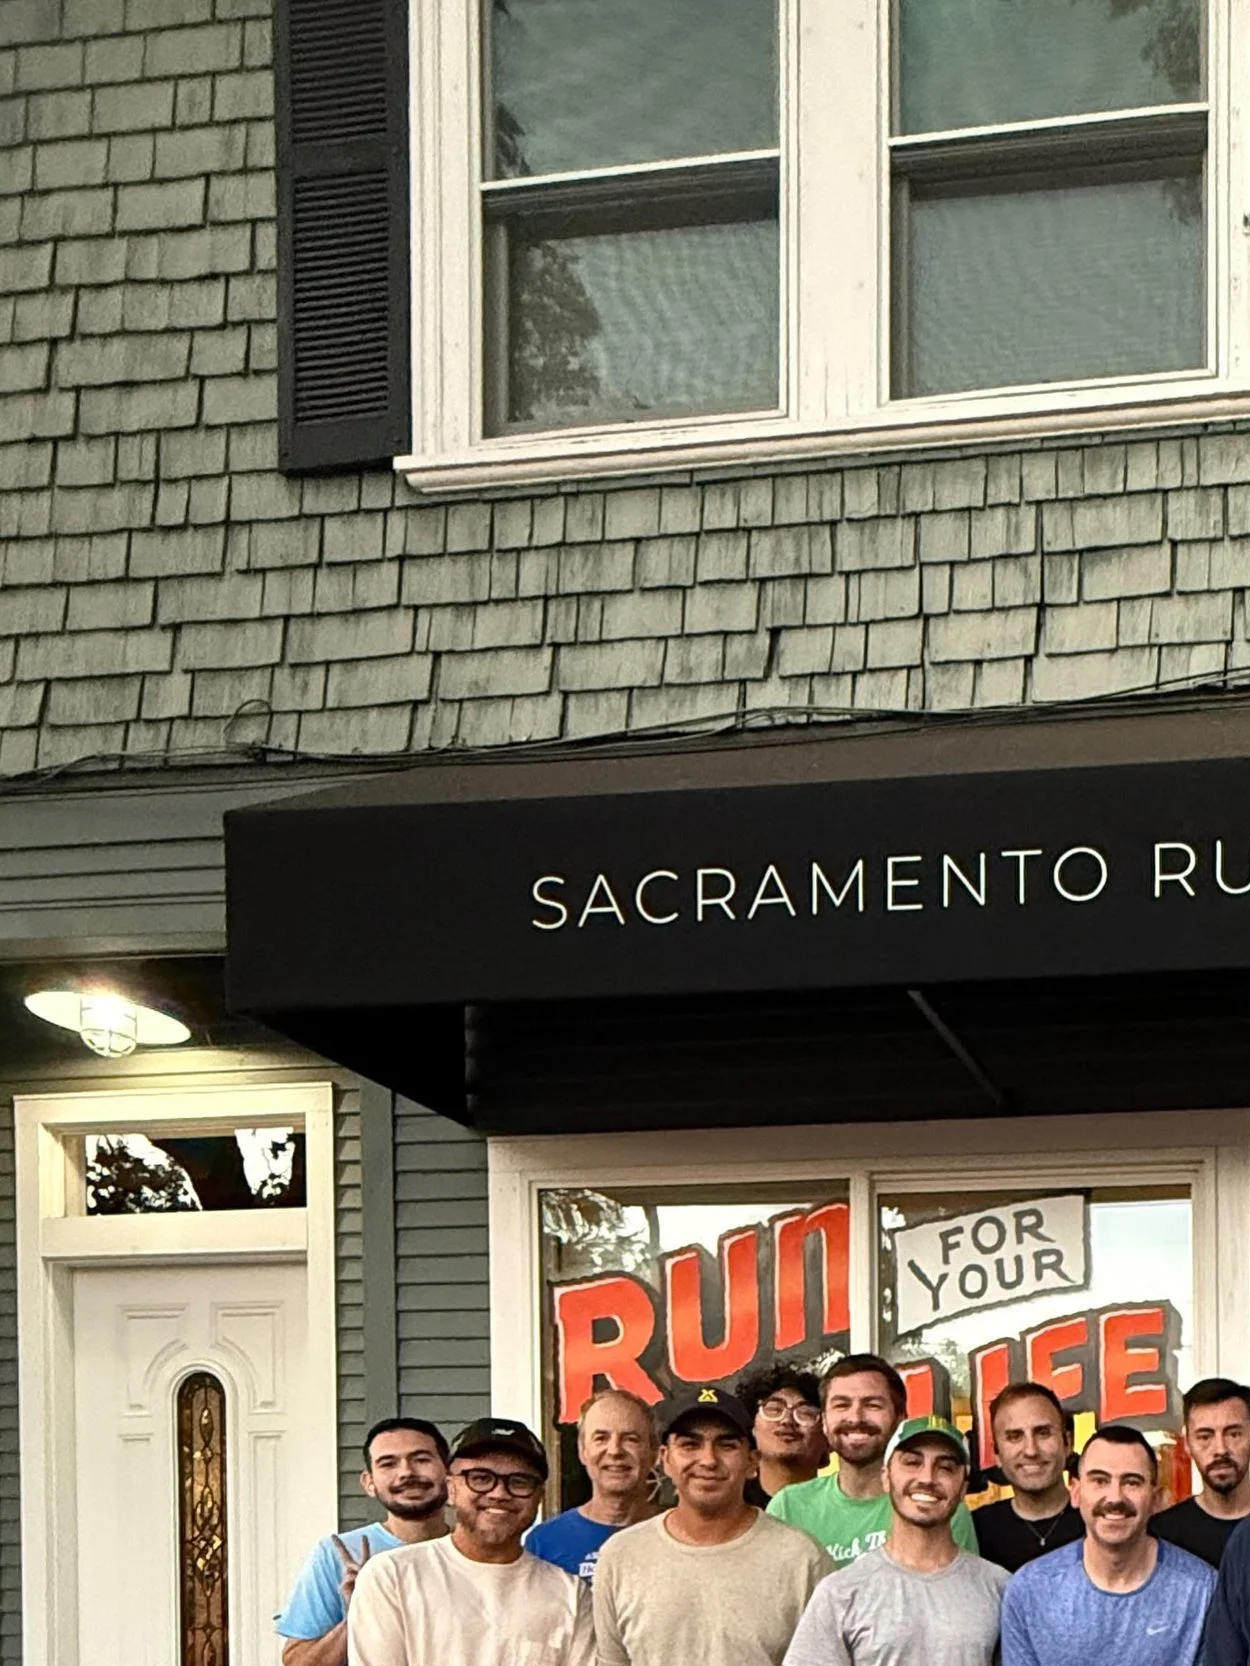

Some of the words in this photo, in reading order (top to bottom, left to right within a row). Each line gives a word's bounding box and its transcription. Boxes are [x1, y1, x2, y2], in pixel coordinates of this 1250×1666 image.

[533, 847, 1107, 929] SACRAMENTO
[938, 1208, 1056, 1265] FOR
[907, 1248, 1077, 1311] YOUR
